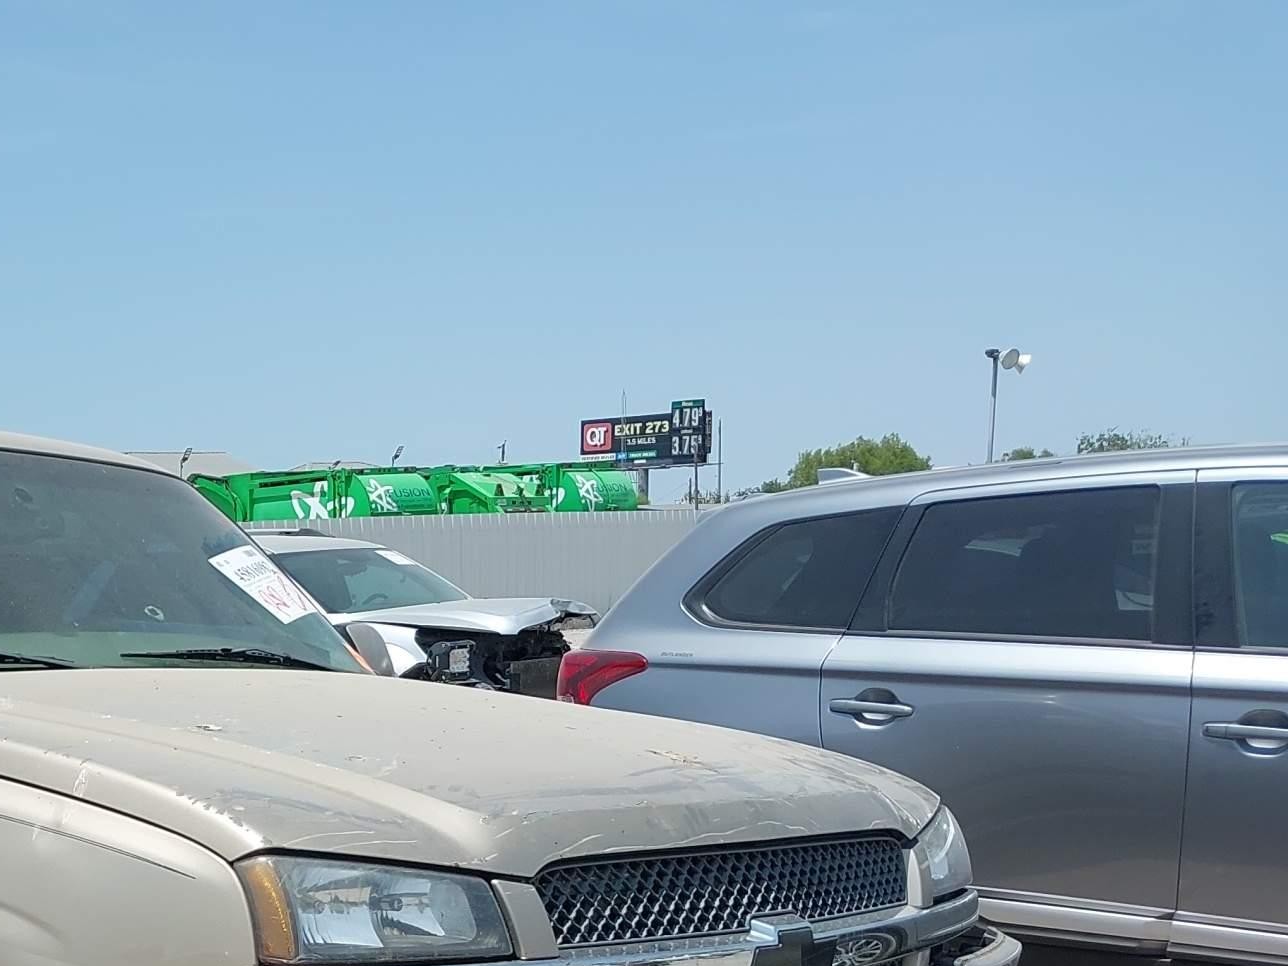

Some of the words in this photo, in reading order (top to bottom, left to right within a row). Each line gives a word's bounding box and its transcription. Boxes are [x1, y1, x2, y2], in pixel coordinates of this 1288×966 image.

[586, 427, 607, 447] QT
[614, 423, 642, 436] EXIT
[645, 421, 670, 434] 273
